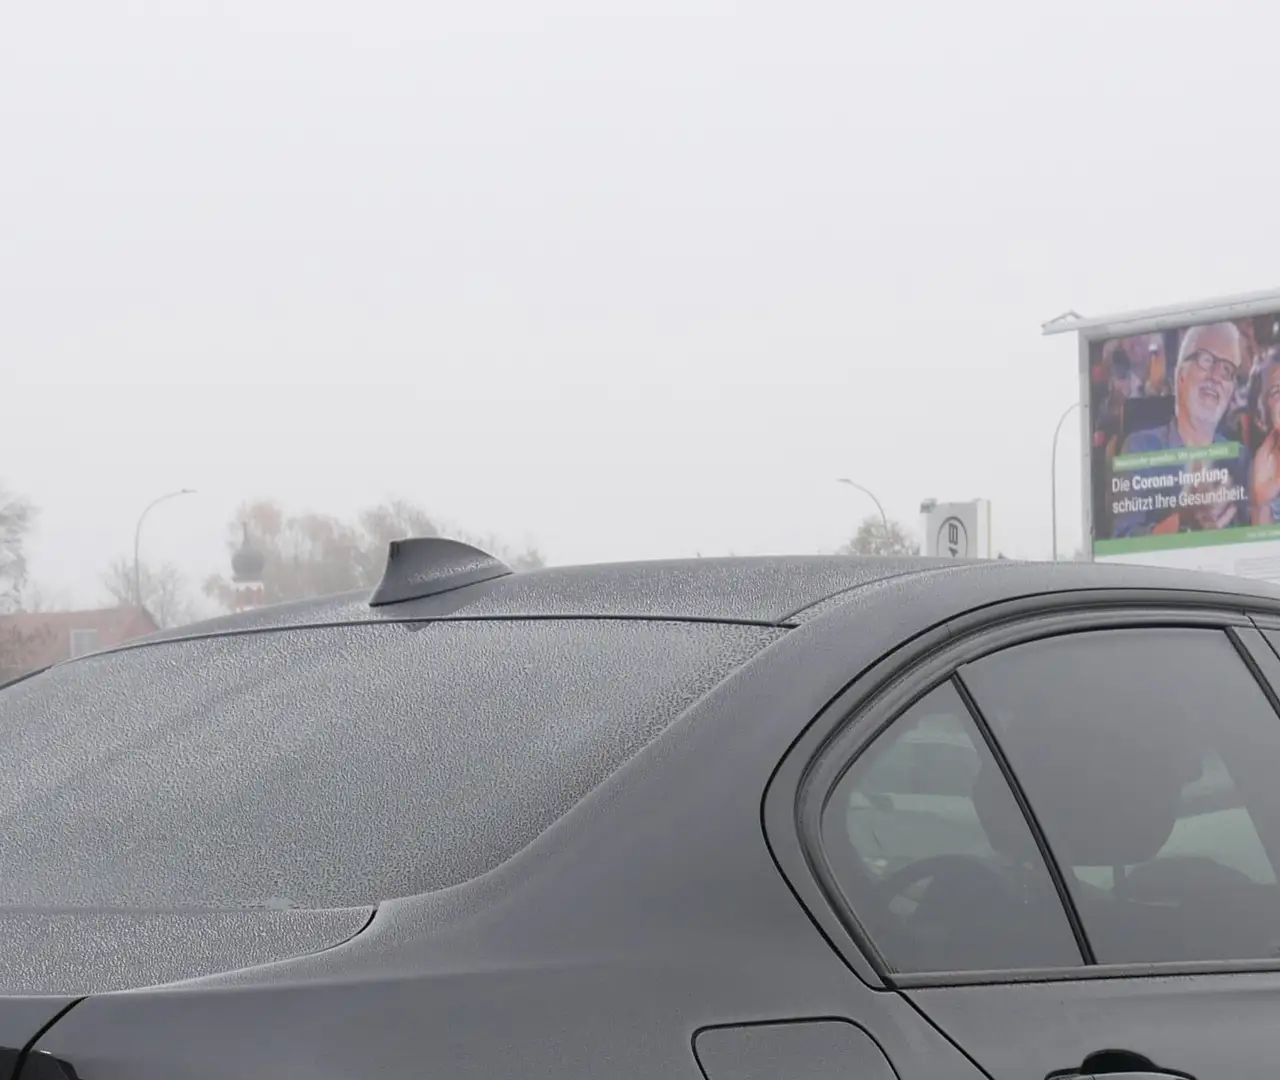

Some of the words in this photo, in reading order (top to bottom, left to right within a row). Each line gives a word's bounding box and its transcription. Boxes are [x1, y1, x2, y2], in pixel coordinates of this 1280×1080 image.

[1111, 477, 1131, 493] Die
[1132, 467, 1229, 490] Corona-Impfung
[1112, 496, 1153, 513] schützt
[1155, 492, 1177, 508] Ihre
[1179, 485, 1249, 507] Gesundheit.
